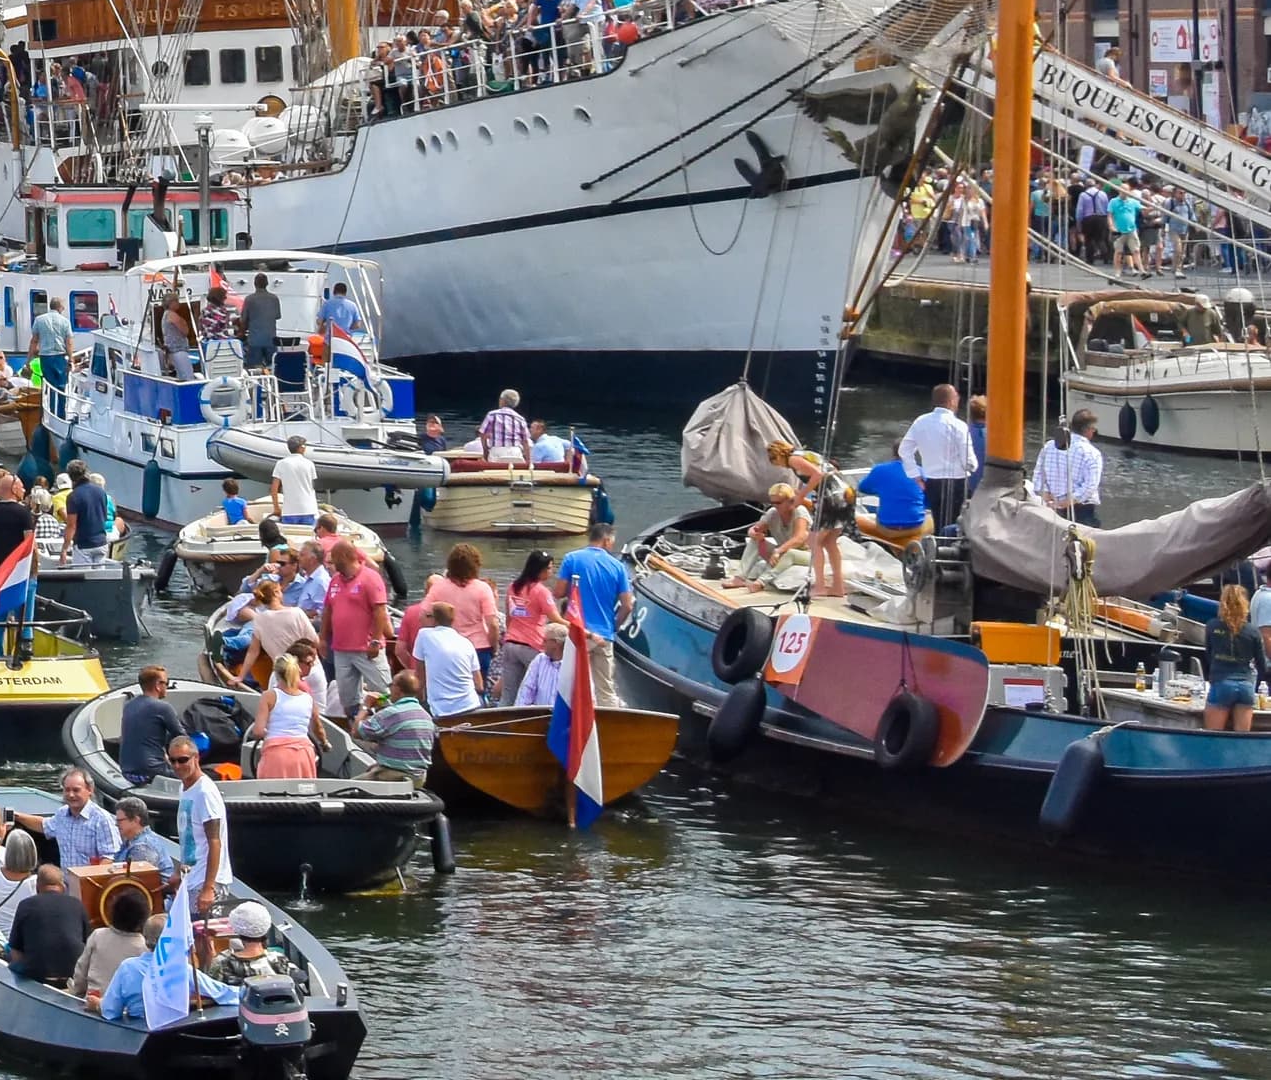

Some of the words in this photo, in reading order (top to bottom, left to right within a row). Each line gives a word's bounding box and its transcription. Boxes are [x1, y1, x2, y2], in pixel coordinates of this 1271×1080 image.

[1038, 63, 1124, 118] BUQUE
[1125, 105, 1233, 172] ESCUELA
[779, 631, 807, 654] 125
